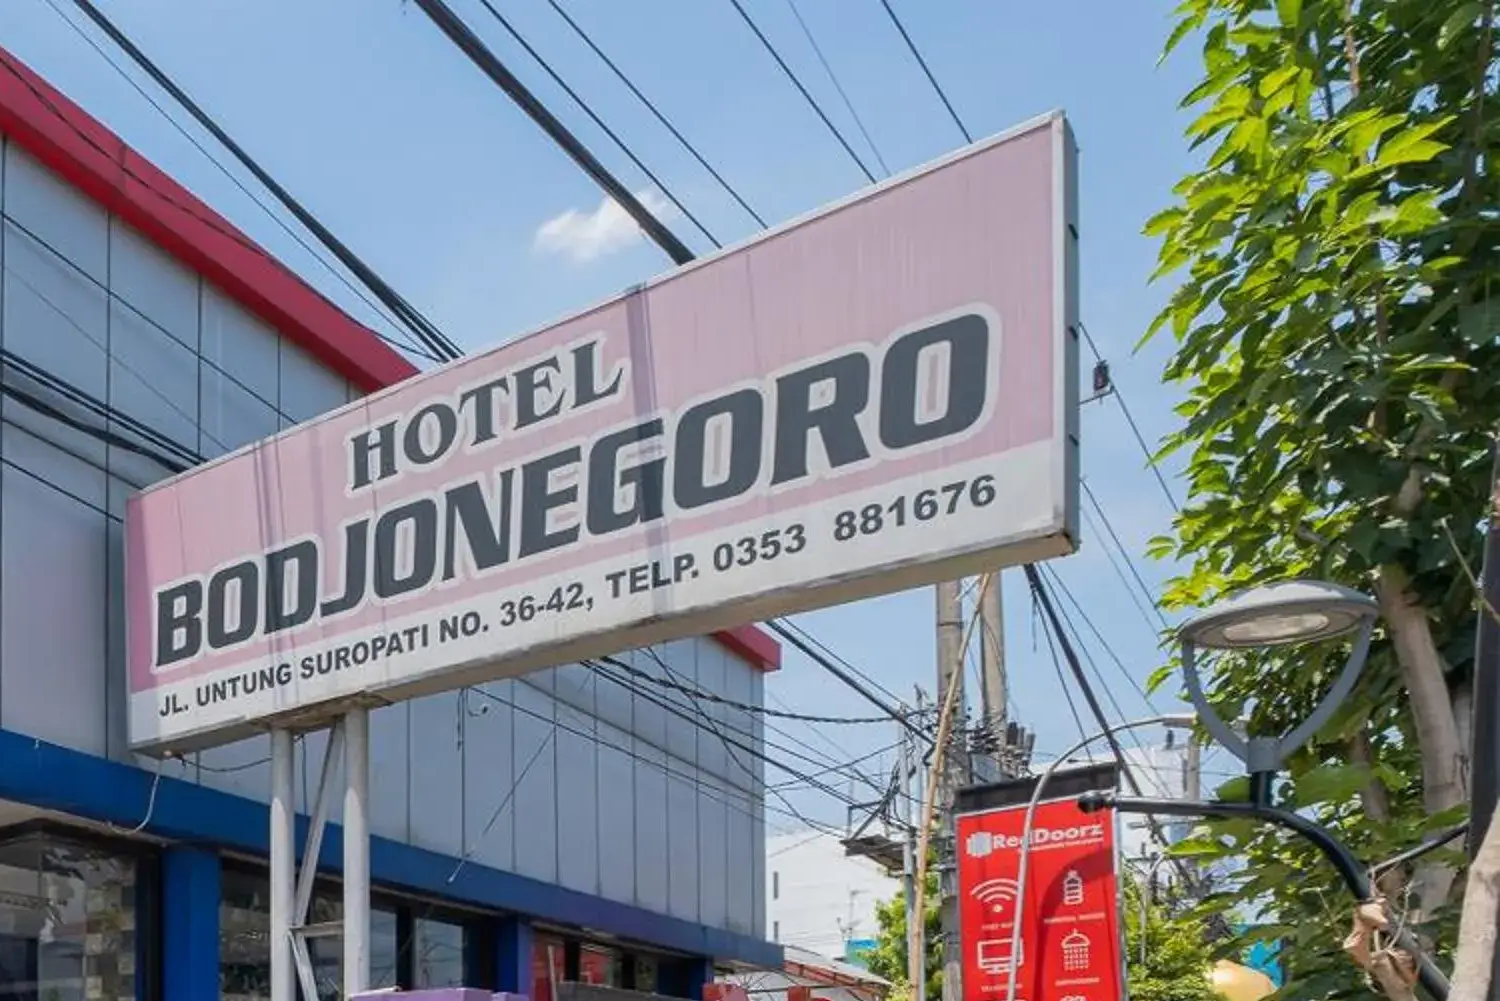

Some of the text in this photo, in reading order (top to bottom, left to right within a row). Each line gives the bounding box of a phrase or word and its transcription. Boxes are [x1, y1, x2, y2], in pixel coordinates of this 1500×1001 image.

[155, 313, 989, 667] BODJONEGORO
[351, 340, 623, 491] HOTEL
[159, 473, 997, 718] JL. UNTUNG SUROPATI NO. 36-42, TELP. 0353 881676
